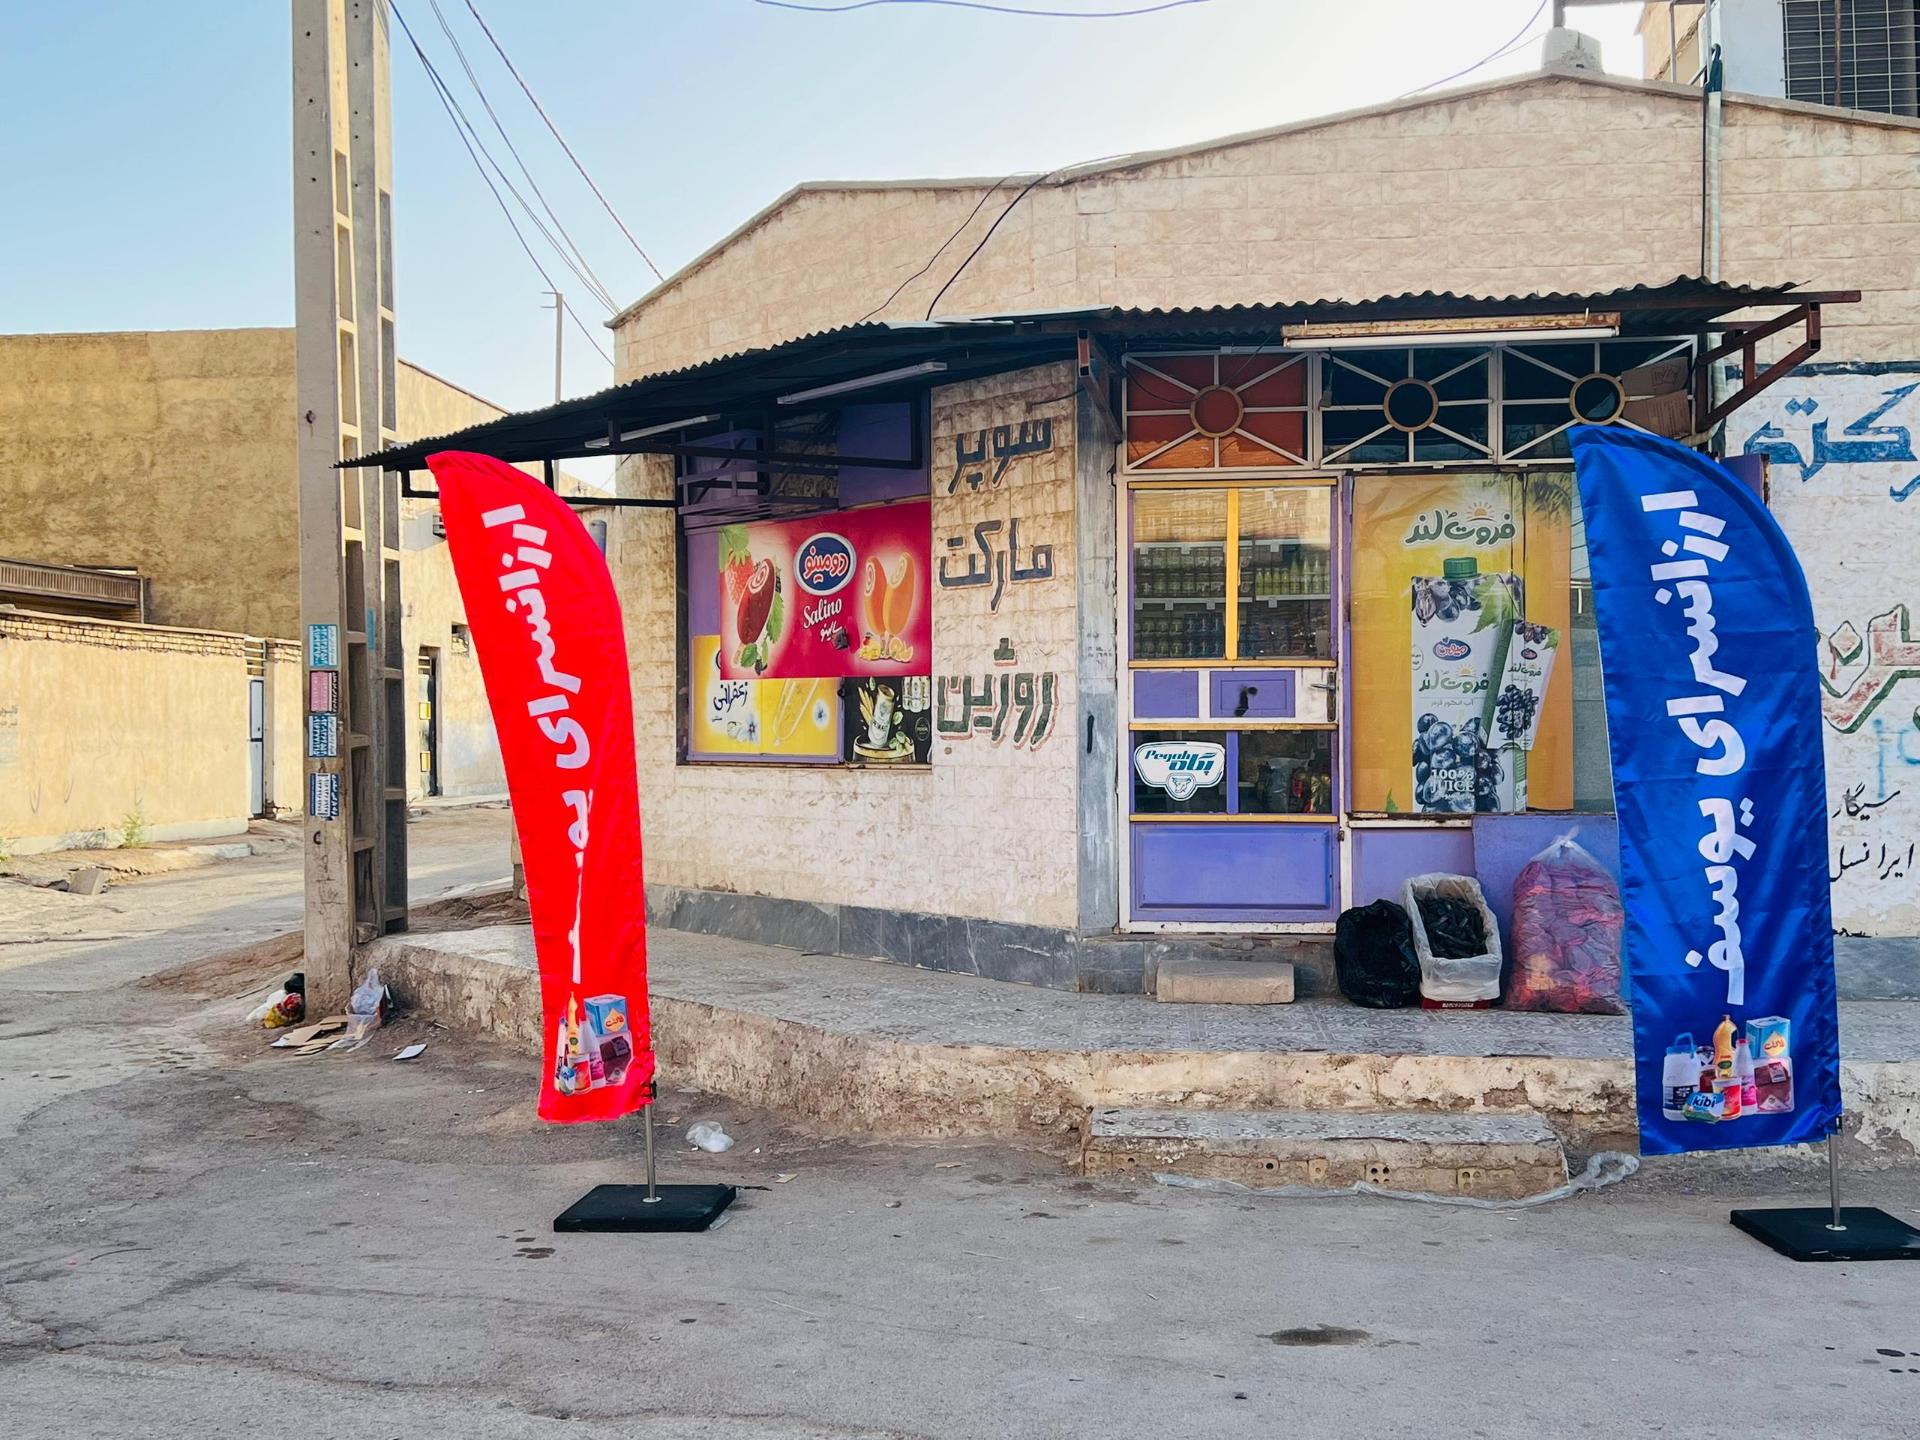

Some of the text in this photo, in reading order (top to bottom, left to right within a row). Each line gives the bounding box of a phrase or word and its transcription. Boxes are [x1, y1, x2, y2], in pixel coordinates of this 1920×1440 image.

[948, 417, 1054, 494] سوپر
[803, 546, 849, 584] دومینو
[939, 517, 1054, 612] مارکت
[803, 598, 843, 629] Salino
[481, 503, 591, 769] ارزانسرای
[713, 681, 748, 713] زعفرانی
[937, 637, 1055, 747] روژین
[1144, 750, 1191, 762] Pegah
[1168, 752, 1217, 776] پگاه
[1641, 489, 1757, 1006] ارزانسرای یوسف
[1430, 780, 1475, 794] JUICE
[1431, 768, 1474, 780] 100%
[1832, 782, 1901, 821] سیگار
[1829, 842, 1915, 882] ایرانسل
[1692, 1095, 1717, 1108] kibi
